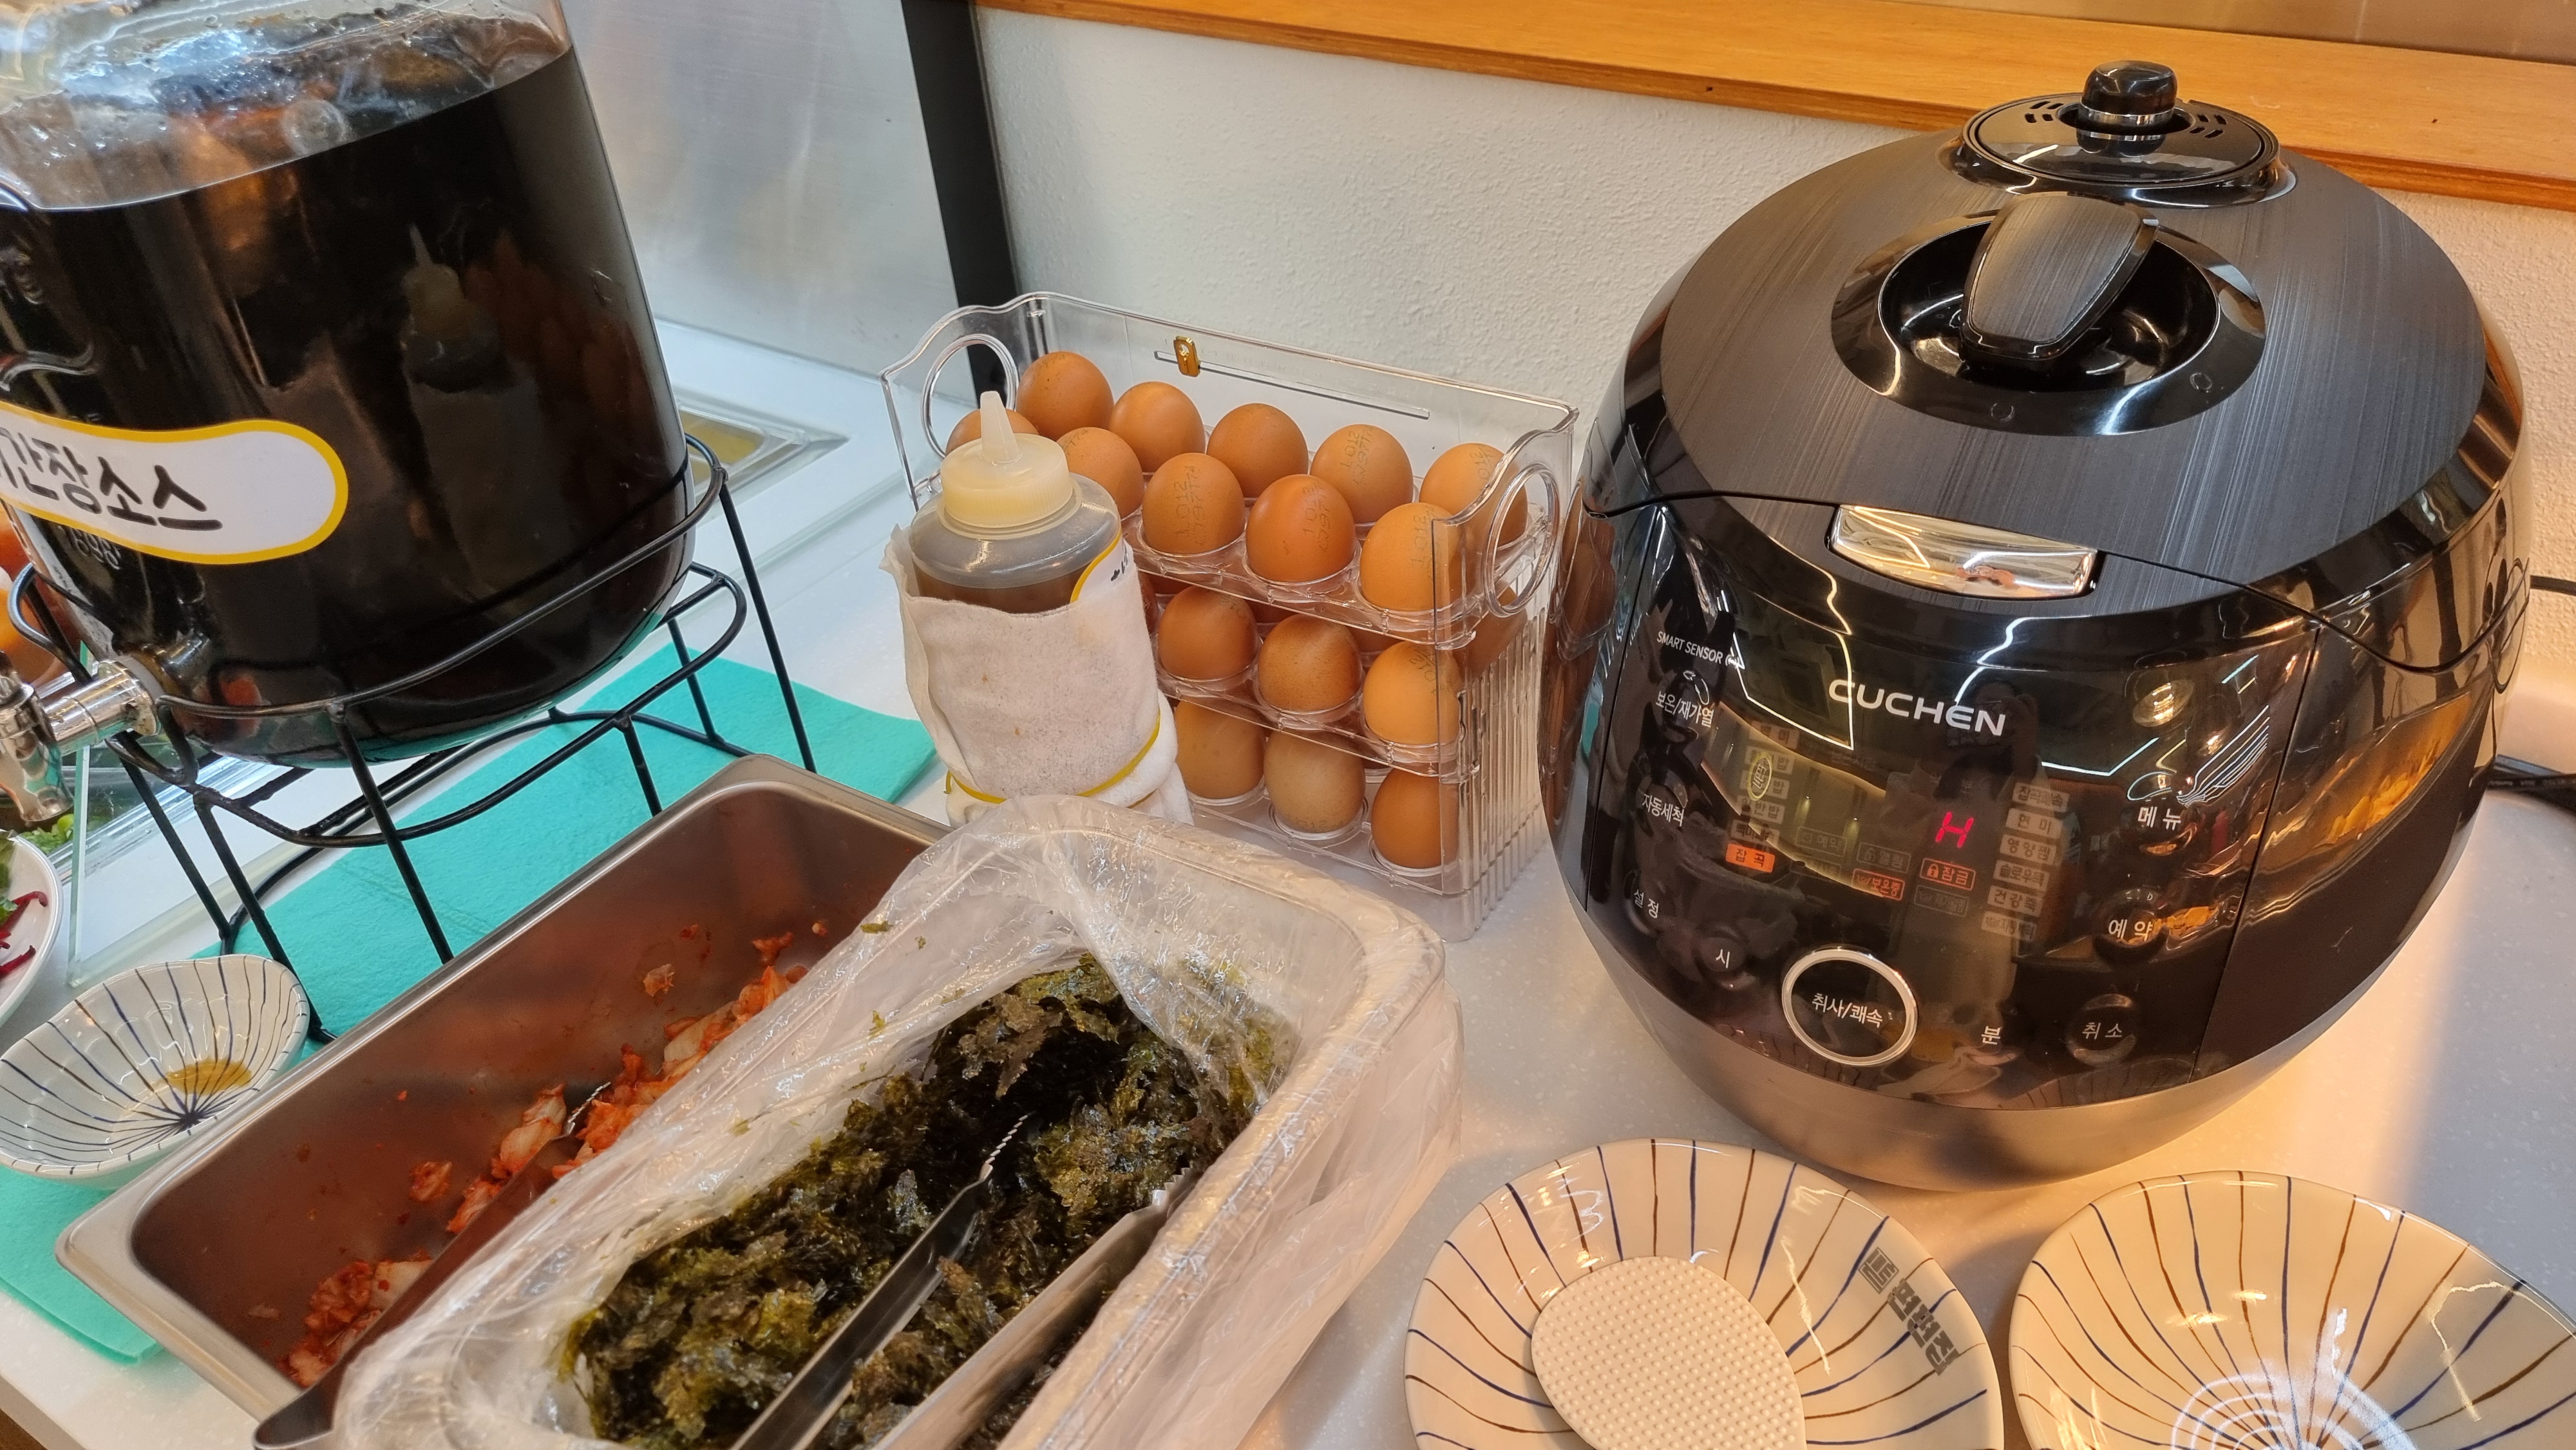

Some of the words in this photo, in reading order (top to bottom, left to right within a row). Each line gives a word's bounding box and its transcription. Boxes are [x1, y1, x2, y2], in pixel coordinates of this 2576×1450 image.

[1656, 631, 1686, 652] SMART
[1685, 641, 1723, 664] SENSOR
[1655, 690, 1714, 728] 보온/재가열
[1828, 679, 2007, 737] CUCHEN
[1642, 793, 1684, 827] 자동세척
[2137, 806, 2183, 829] 메뉴
[1935, 811, 1975, 849] H
[1942, 867, 1969, 886] 잠금
[1633, 889, 1660, 919] 설정
[2108, 917, 2154, 941] 예약
[1715, 948, 1730, 969] 시
[1811, 993, 1884, 1028] 취사/쾌속
[1981, 1025, 2002, 1046] 분
[2082, 1021, 2123, 1040] 취소
